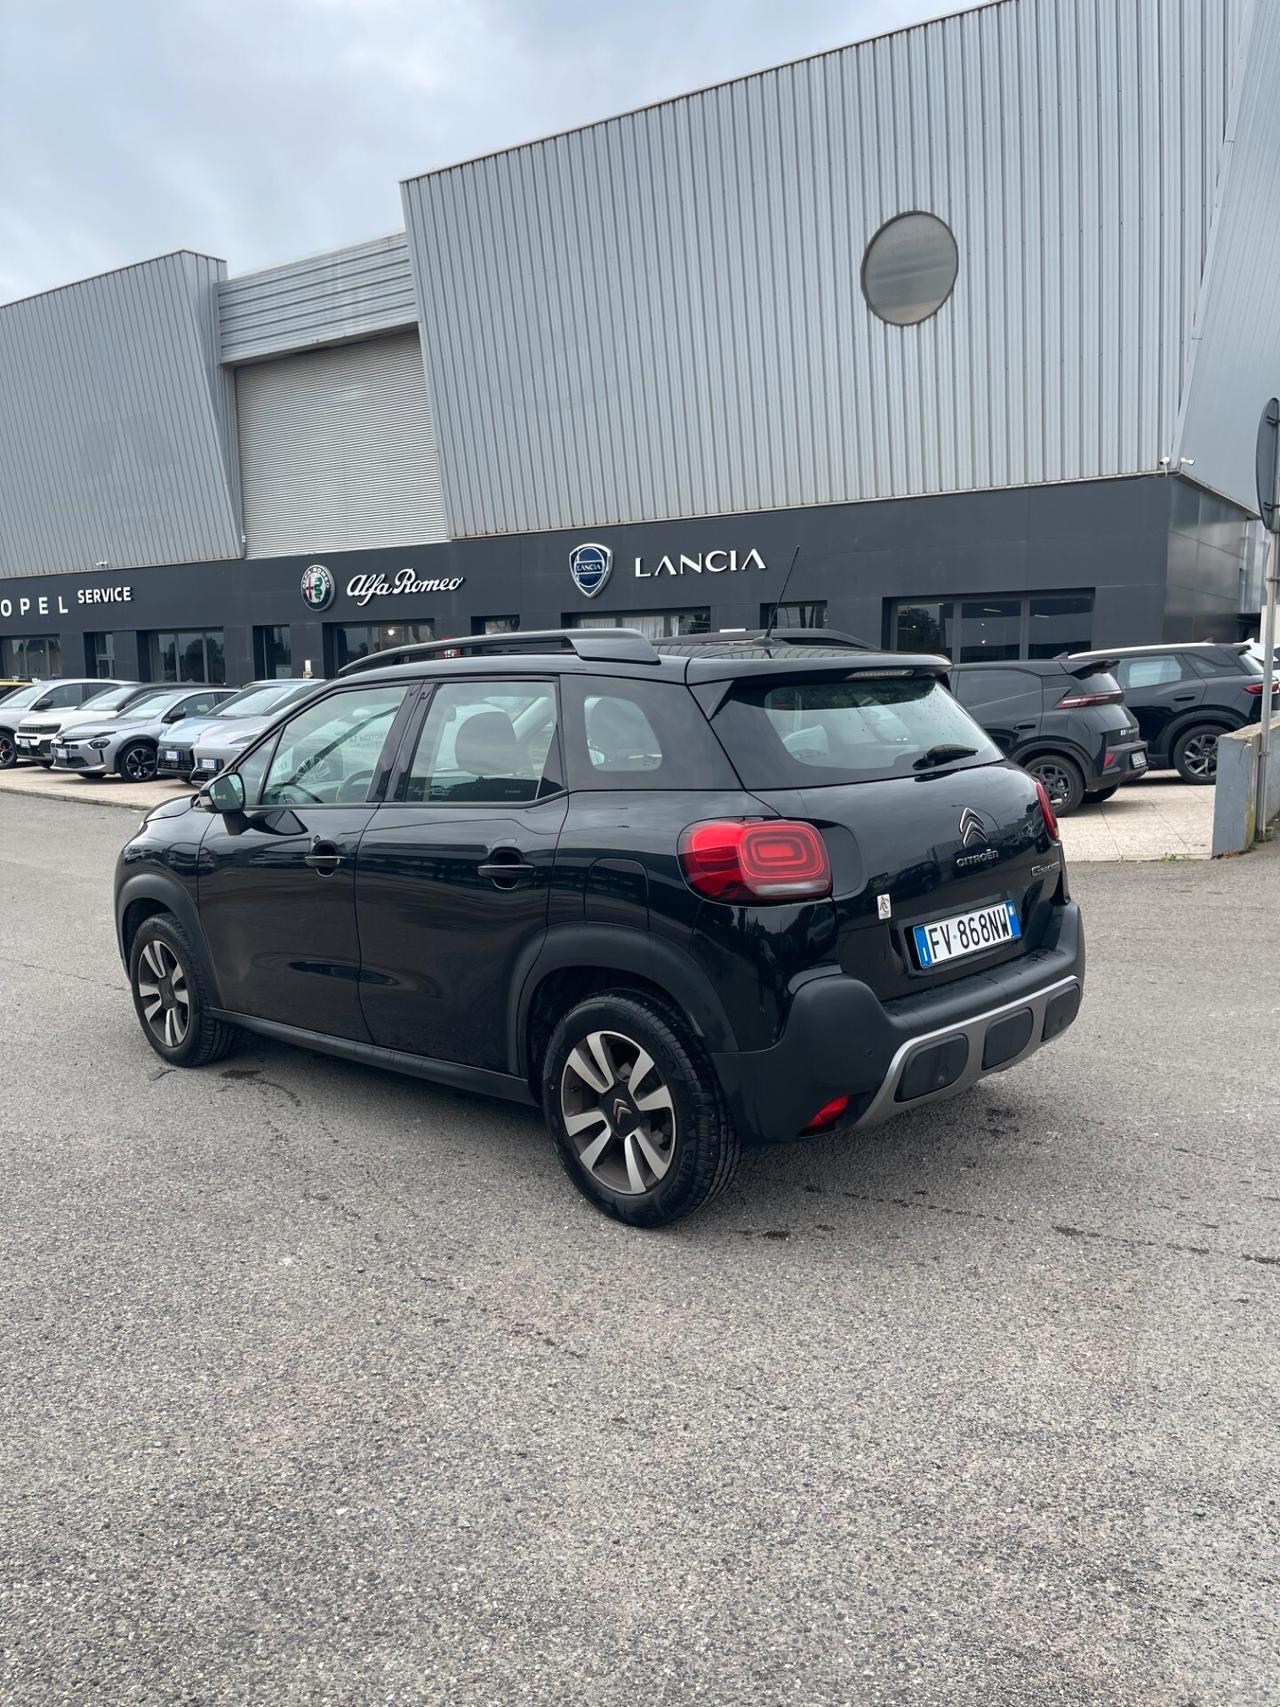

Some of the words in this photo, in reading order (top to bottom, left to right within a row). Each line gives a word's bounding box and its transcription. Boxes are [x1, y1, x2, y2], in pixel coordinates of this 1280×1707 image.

[576, 563, 602, 573] LANCIA
[634, 548, 767, 578] LANCIA
[0, 596, 69, 617] OPEL
[77, 586, 132, 604] SERVICE
[346, 574, 393, 607] Alfa
[392, 567, 464, 596] Romeo
[956, 848, 1000, 868] CITROËN
[927, 924, 952, 960] FV
[957, 907, 1010, 950] 868NW
